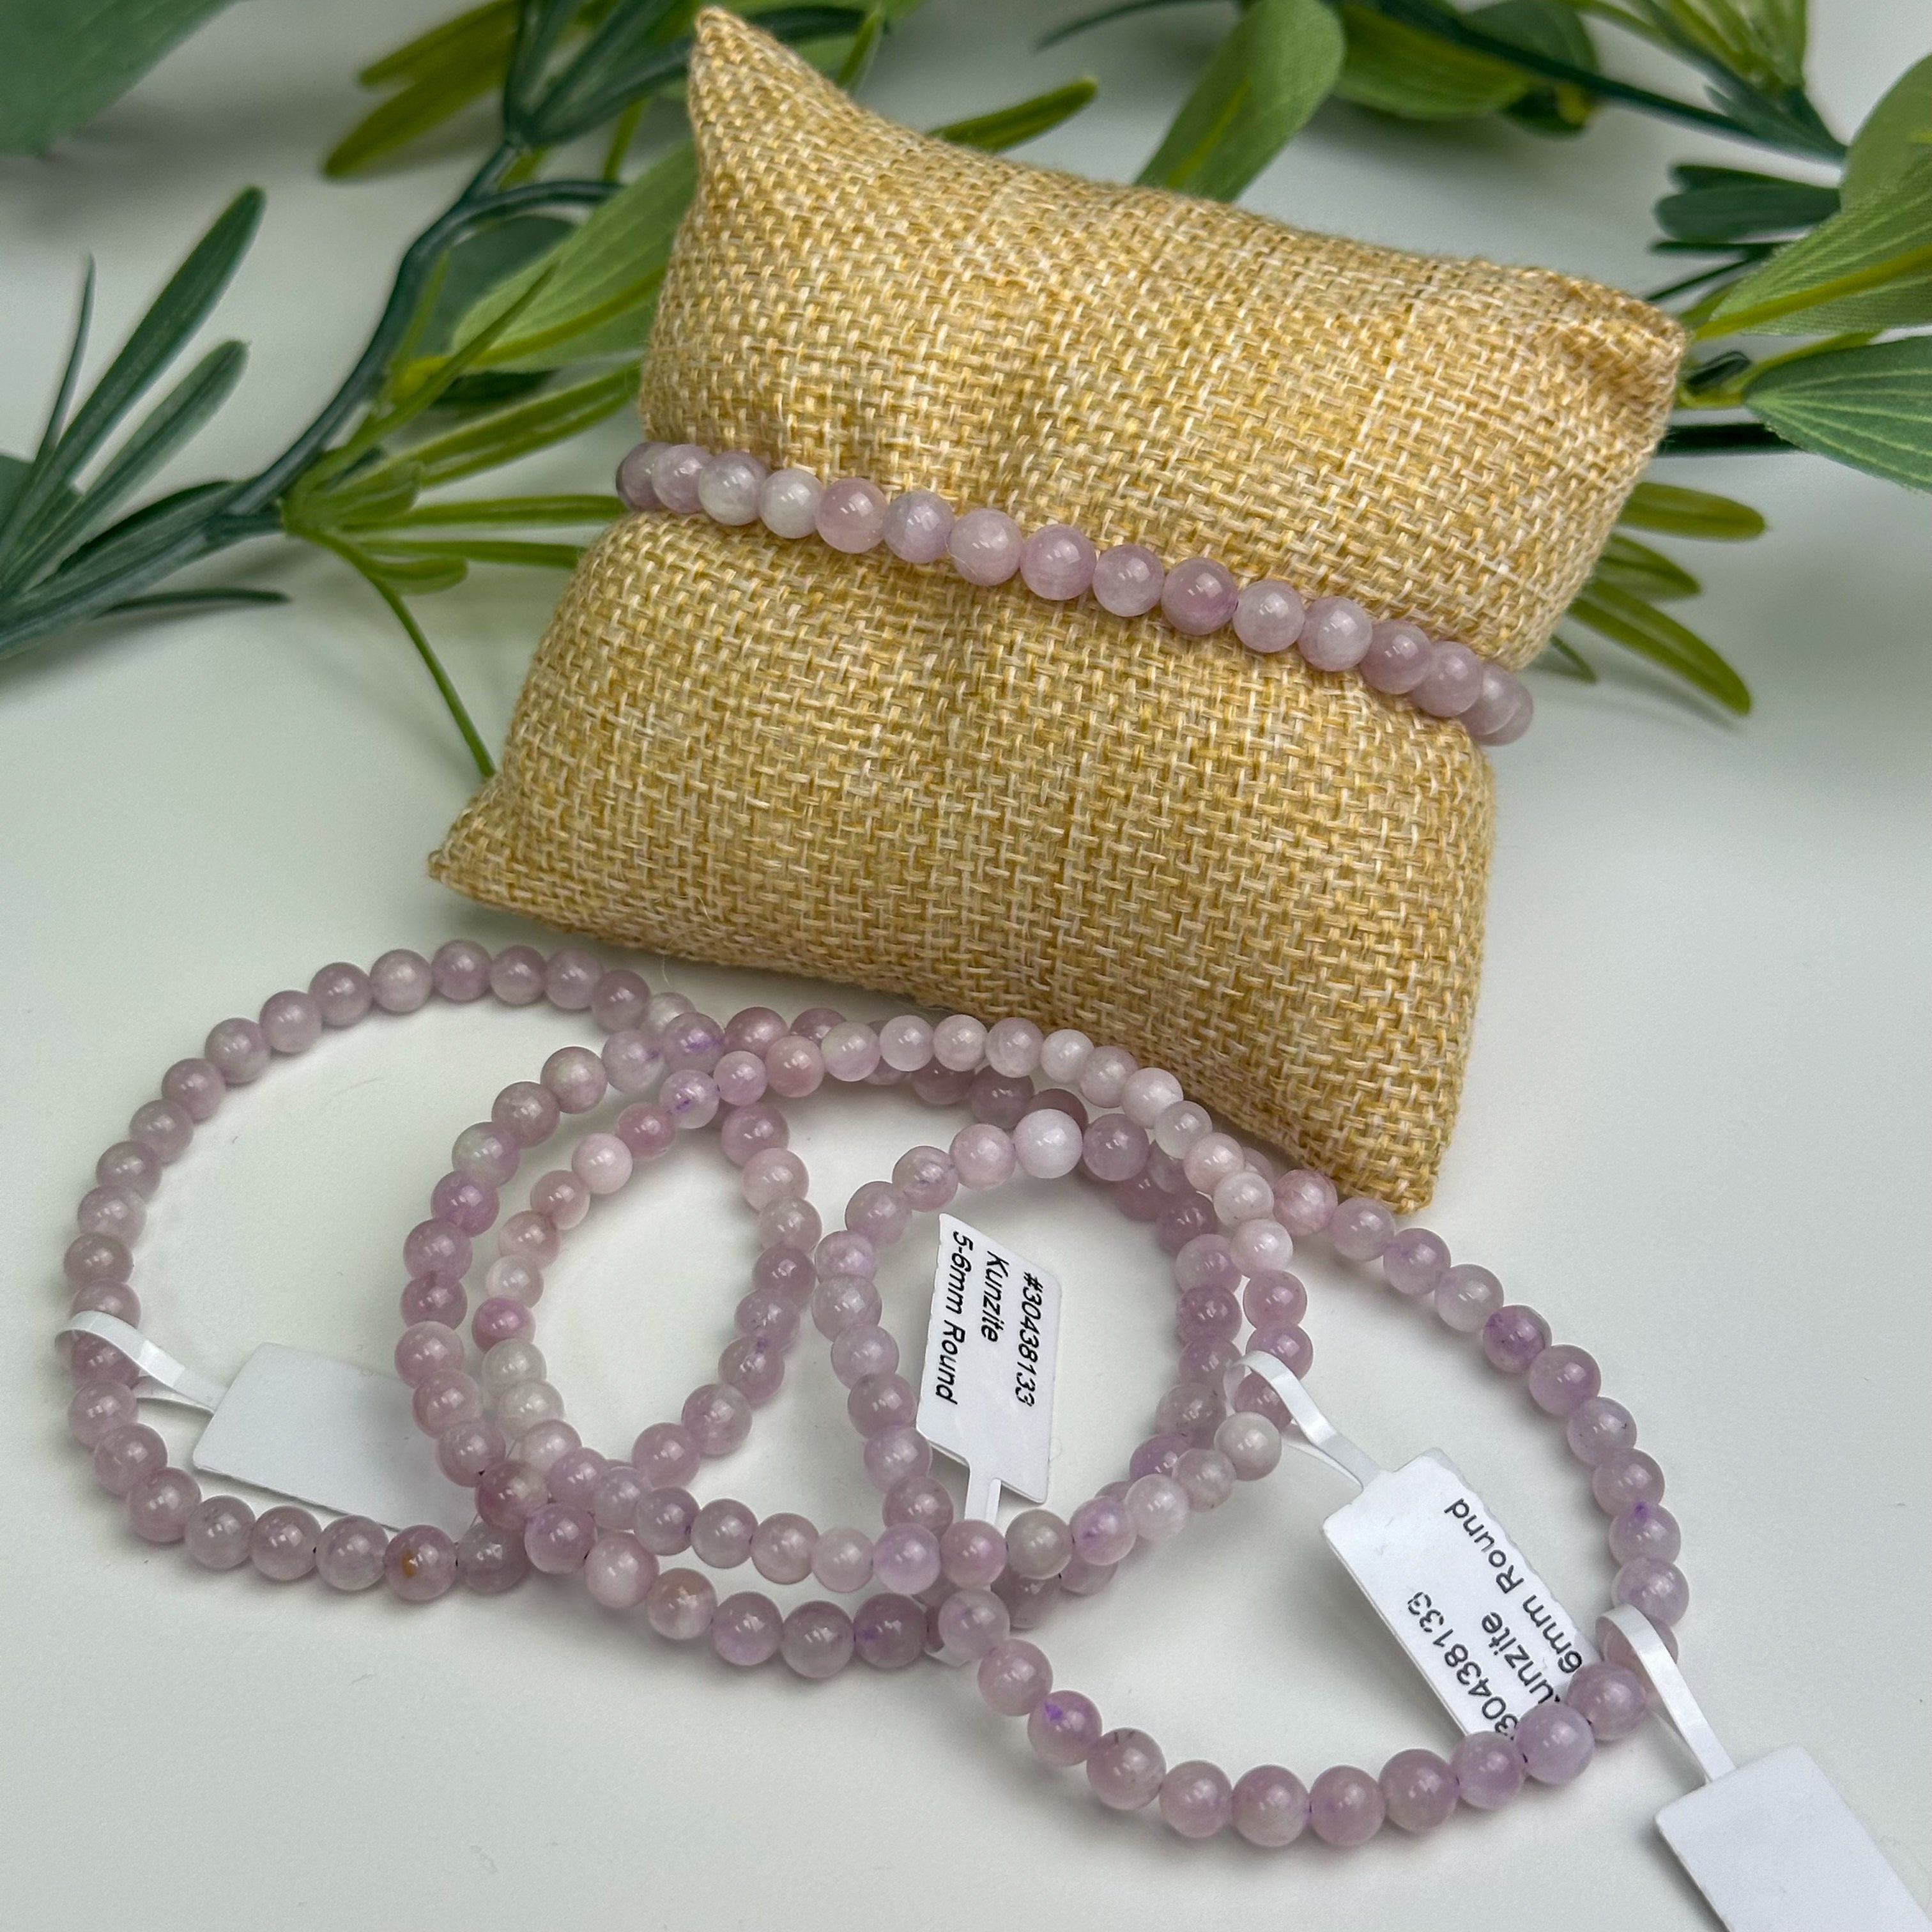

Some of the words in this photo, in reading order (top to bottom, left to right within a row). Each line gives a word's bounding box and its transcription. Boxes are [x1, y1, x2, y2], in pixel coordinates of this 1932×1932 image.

[945, 1231, 974, 1315] 5-6mm
[981, 1250, 1009, 1342] Kunzite
[935, 1319, 966, 1405] Round
[1015, 1271, 1043, 1407] #30438133
[1444, 1498, 1524, 1594] Round
[1407, 1591, 1519, 1737] 30438133
[1482, 1612, 1562, 1705] unzite
[1522, 1595, 1583, 1674] 6mm
